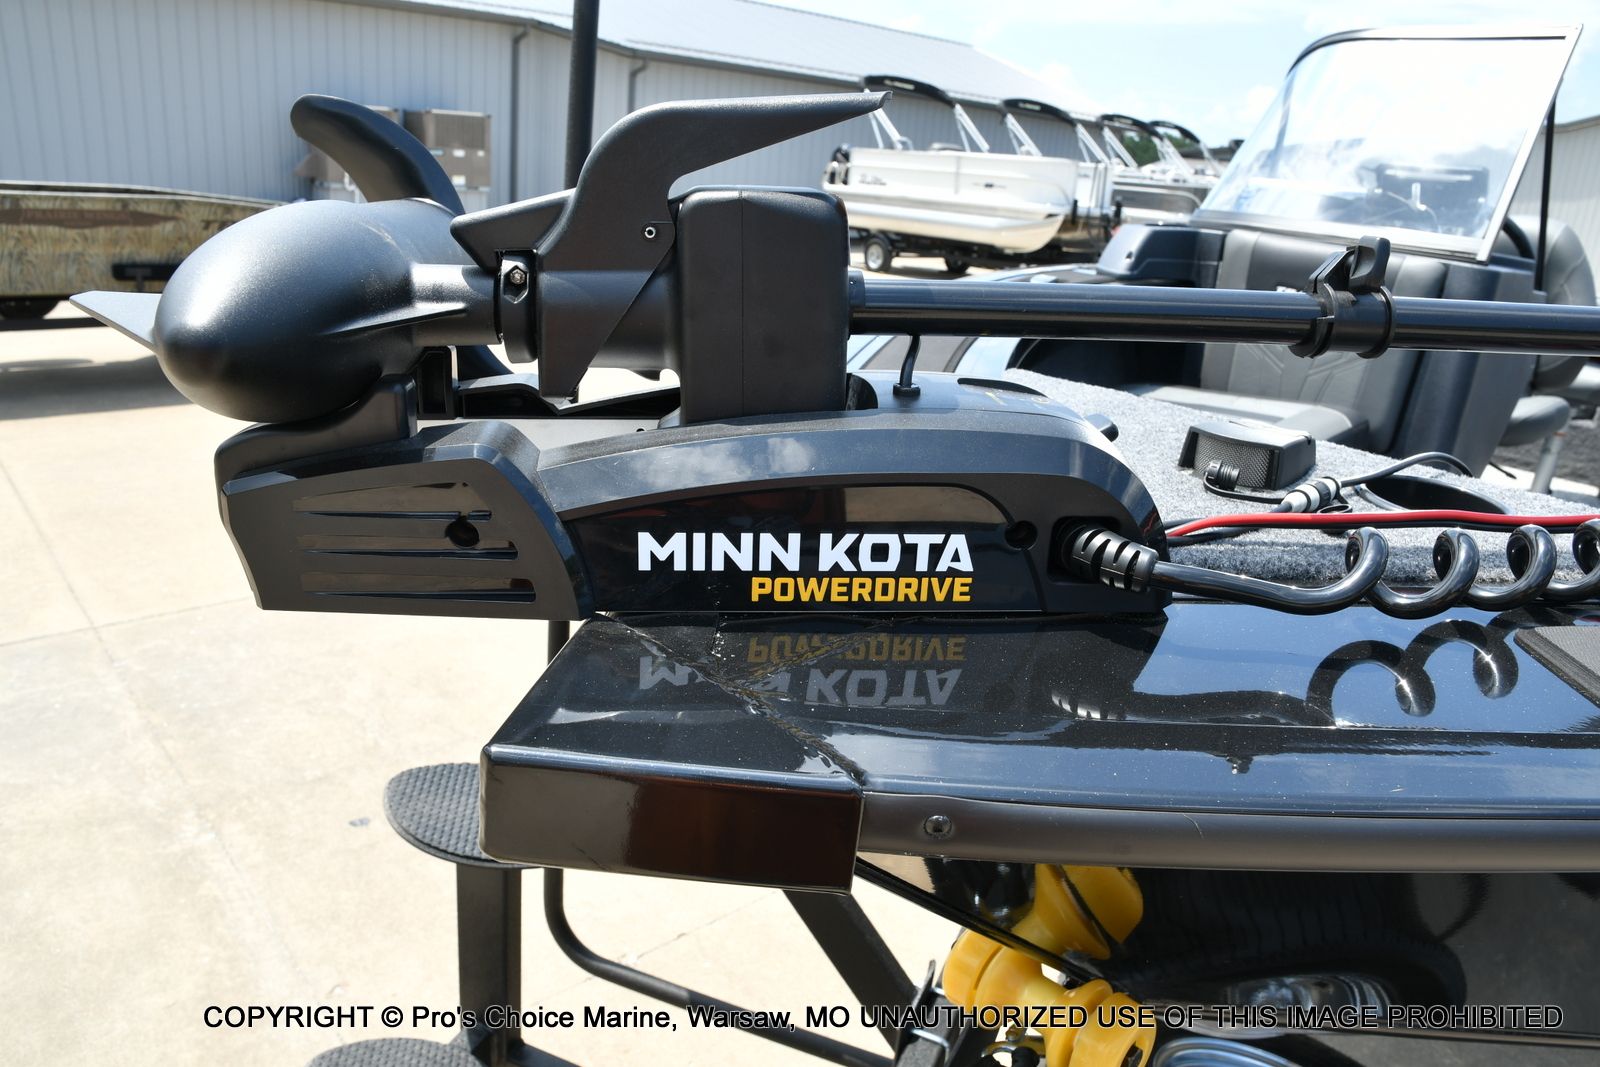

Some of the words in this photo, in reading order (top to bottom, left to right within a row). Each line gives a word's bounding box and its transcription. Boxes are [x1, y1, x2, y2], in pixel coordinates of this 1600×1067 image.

[638, 532, 801, 571] MINN
[818, 533, 974, 572] KOTA
[751, 577, 973, 602] POWERDRIVE
